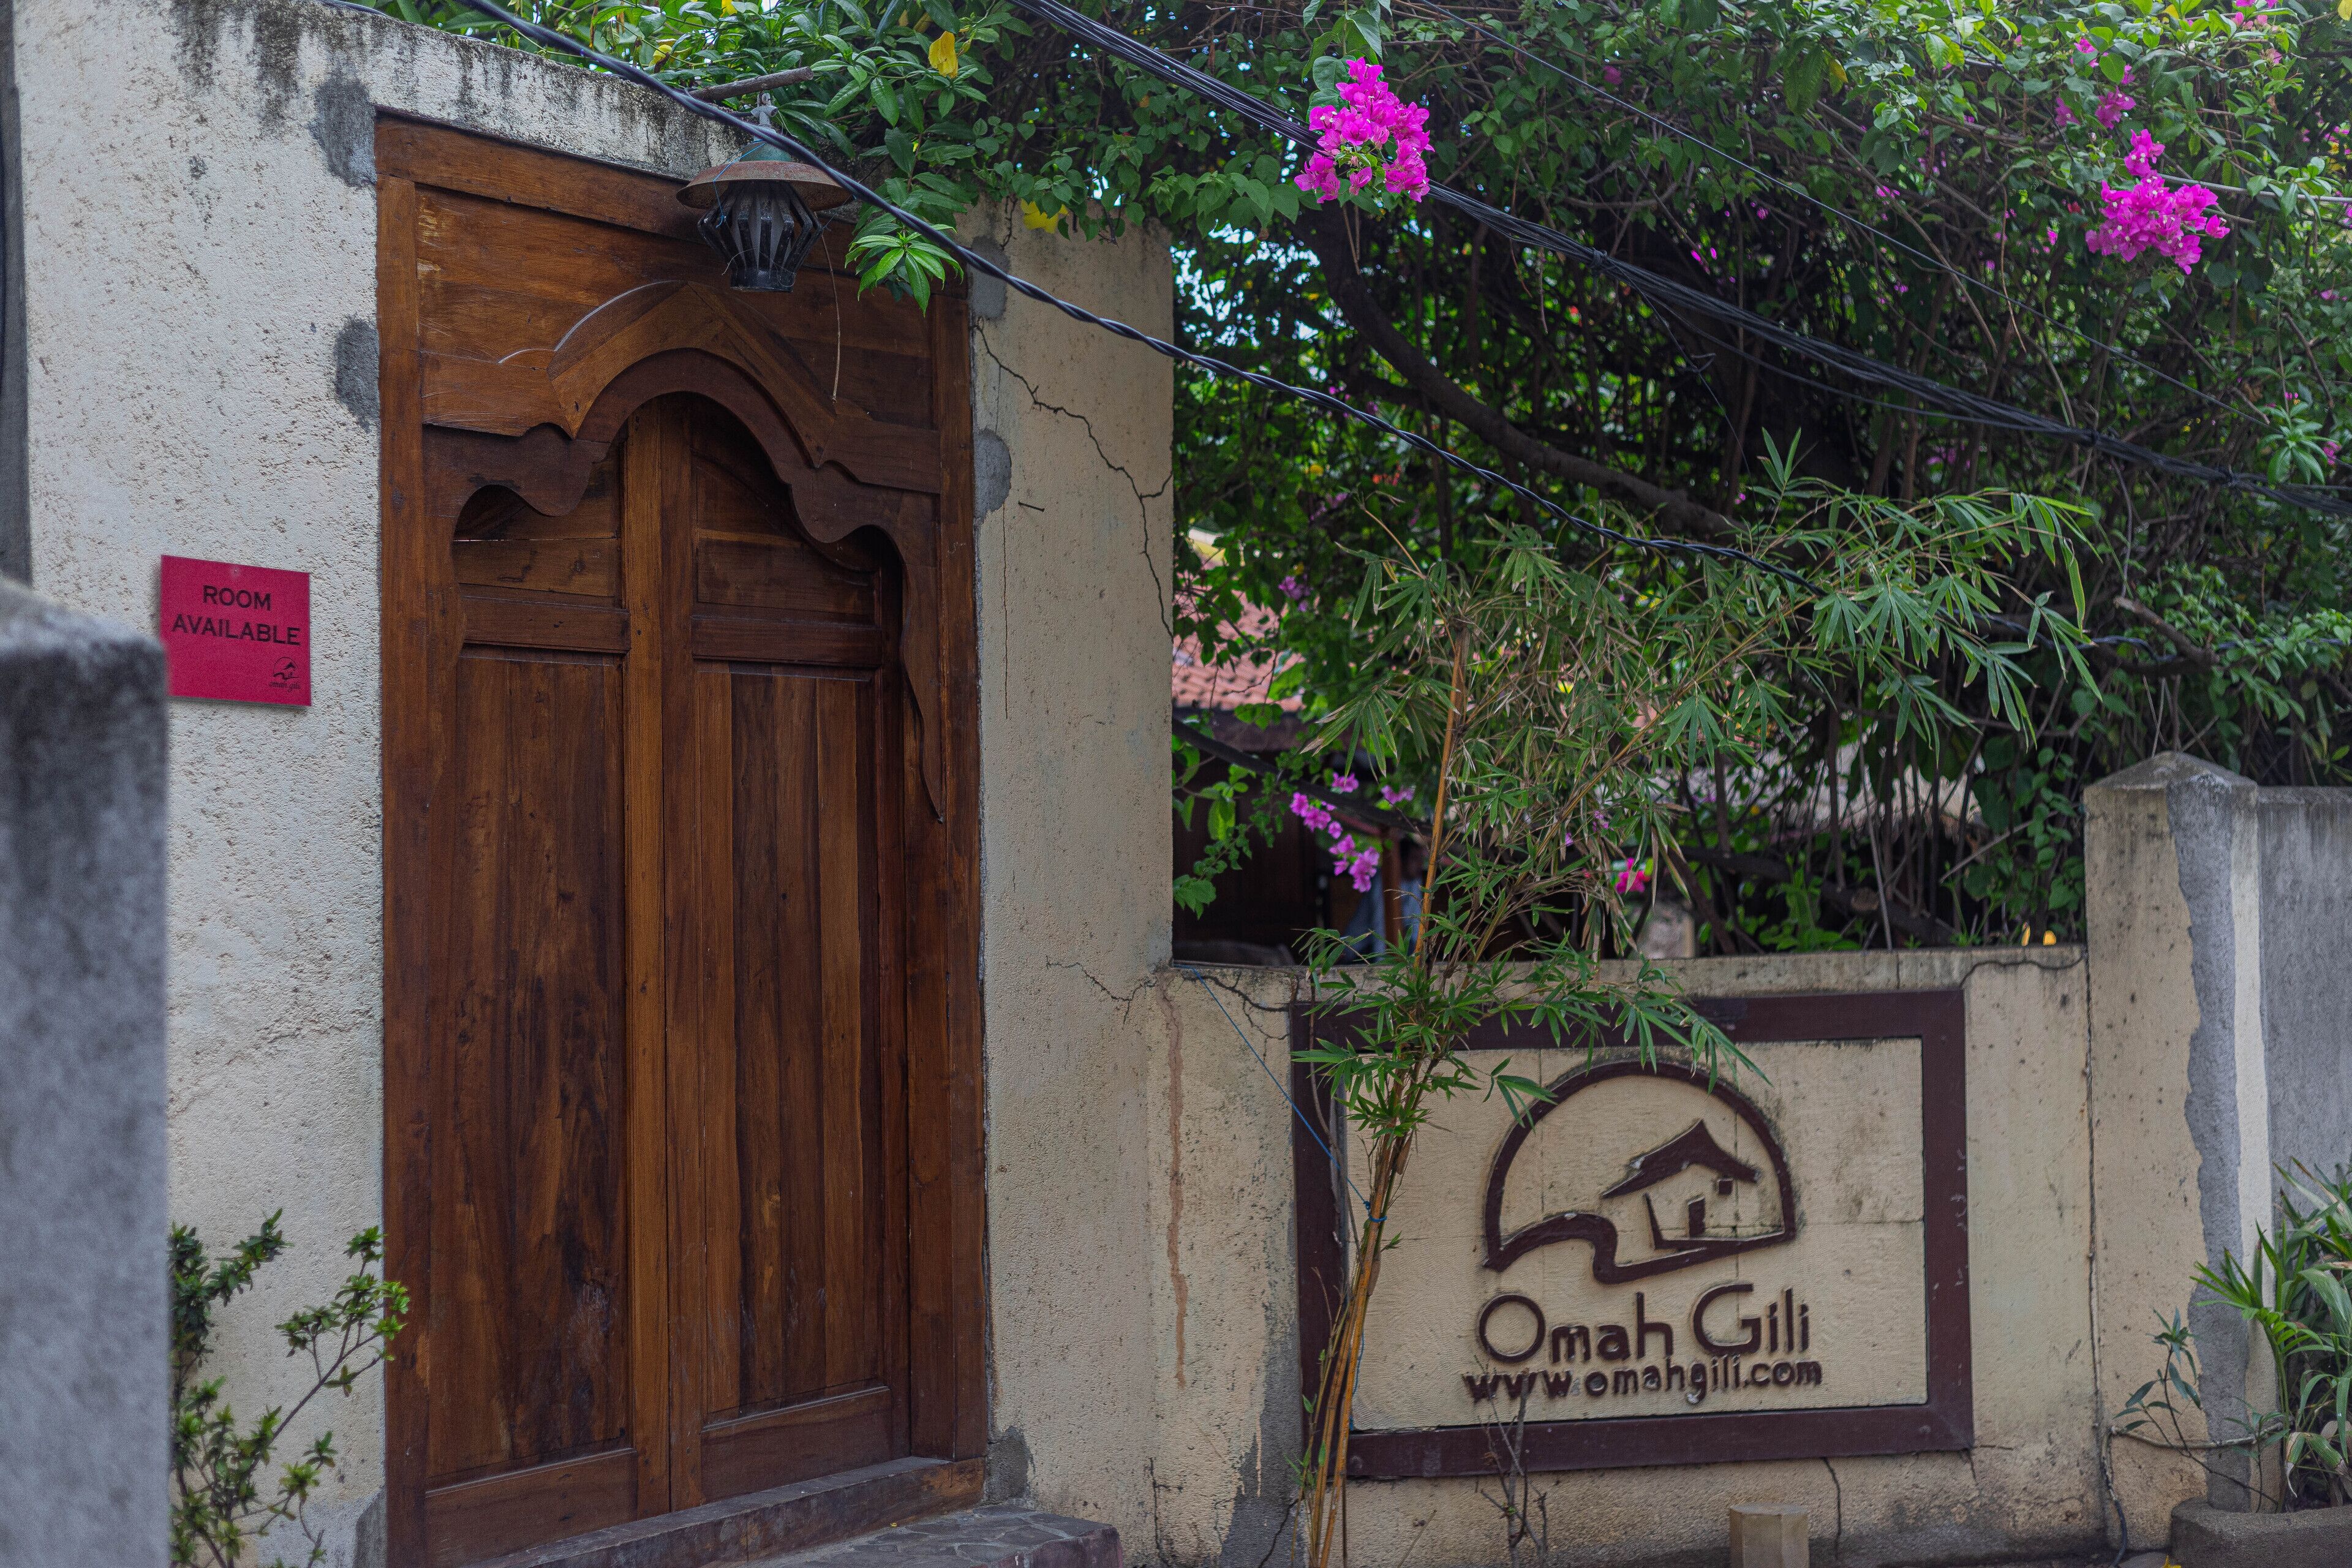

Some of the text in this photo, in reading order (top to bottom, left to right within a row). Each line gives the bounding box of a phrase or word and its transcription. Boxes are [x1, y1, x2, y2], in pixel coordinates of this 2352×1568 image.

[203, 585, 271, 611] ROOM
[172, 614, 301, 646] AVAILABLE
[1477, 1283, 1809, 1363] Omah Gili
